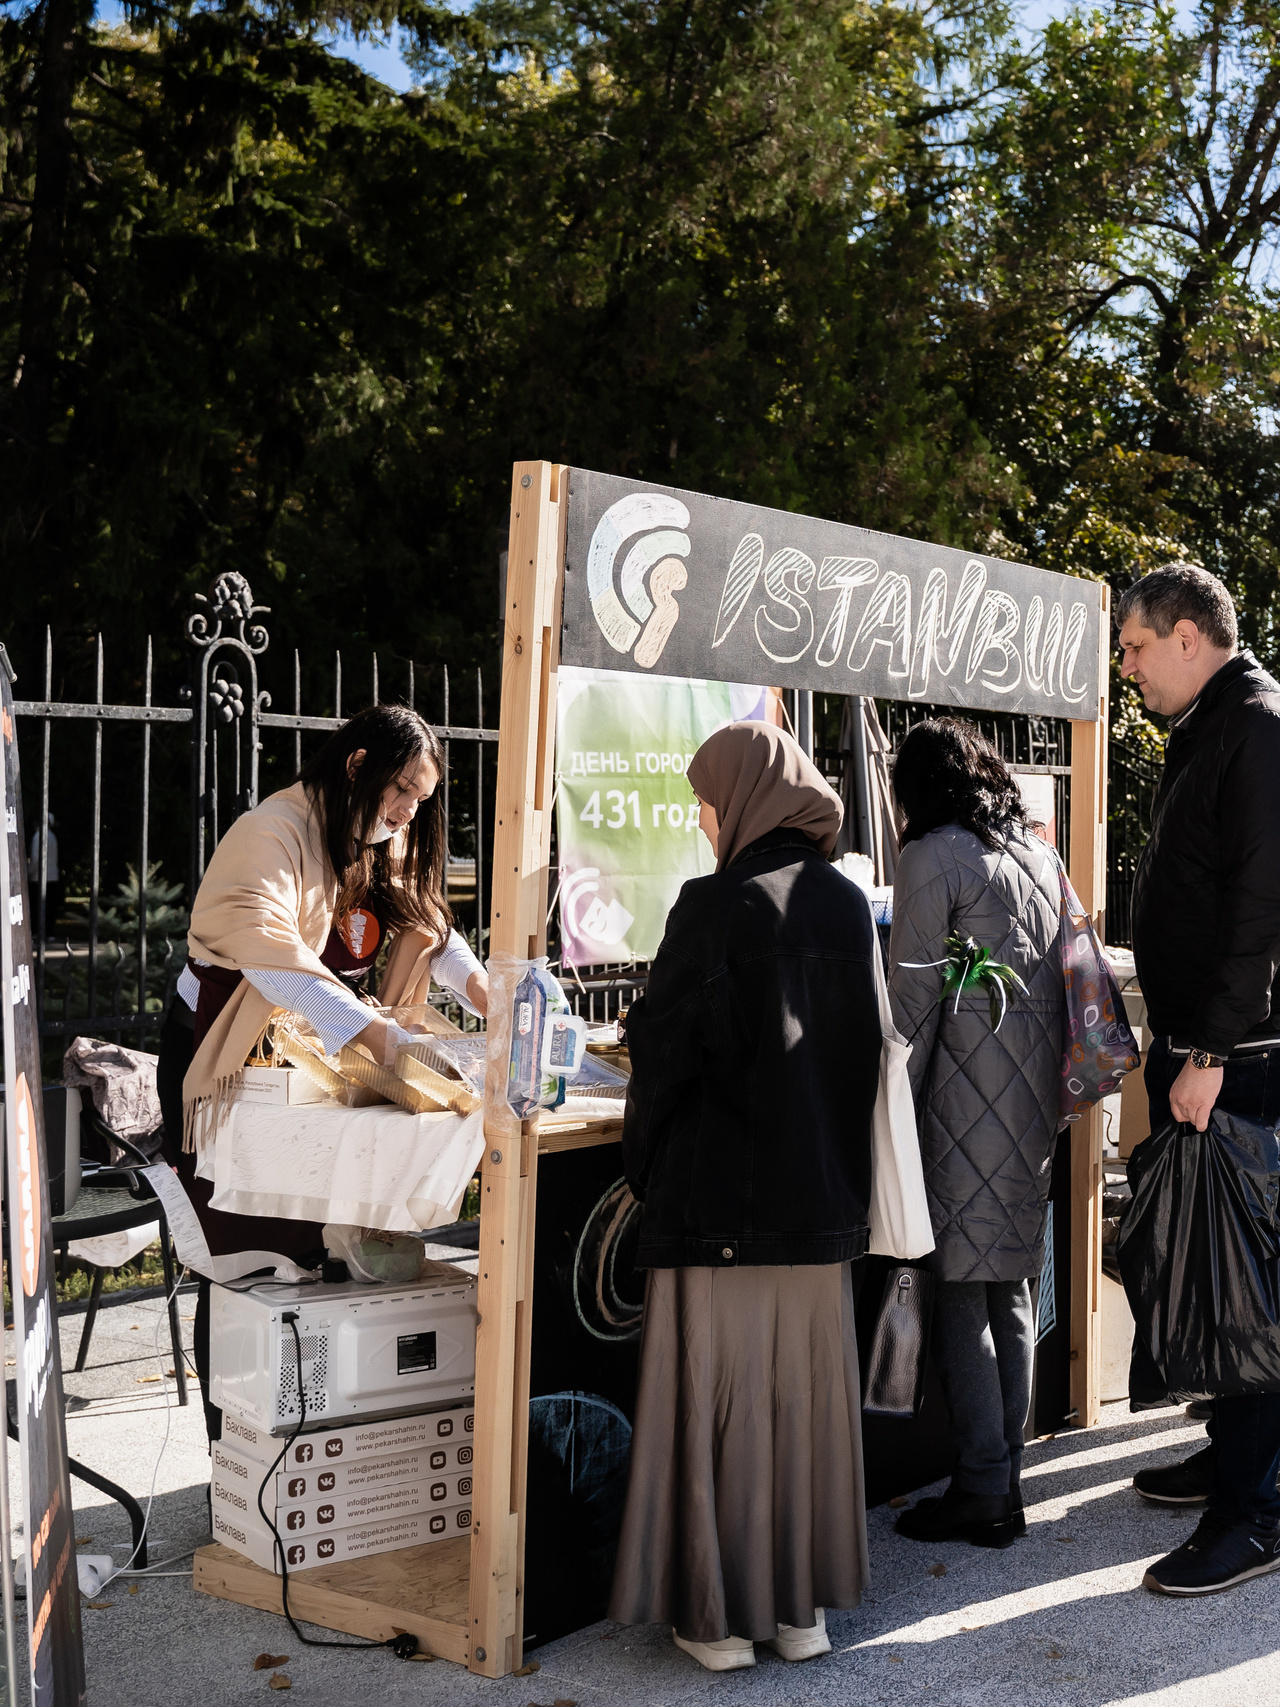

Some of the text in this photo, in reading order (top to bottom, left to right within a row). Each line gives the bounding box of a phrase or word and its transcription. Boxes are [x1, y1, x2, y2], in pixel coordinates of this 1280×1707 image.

[711, 533, 1088, 703] ISTANBUL
[570, 751, 630, 777] ДЕНЬ
[580, 789, 641, 829] 431
[551, 1032, 562, 1061] AURA
[225, 1415, 257, 1444] Баклава
[355, 1423, 426, 1441] info@pekarshahin.ru
[356, 1434, 426, 1451] www.pekarshahin.ru
[215, 1450, 248, 1479] Баклава
[347, 1456, 418, 1475] info@pekarshahin.ru
[348, 1466, 419, 1485] www.pekarshahin.ru
[215, 1482, 247, 1511] Баклава
[346, 1488, 419, 1507] info@pekarshahin.ru
[347, 1498, 419, 1517] www.pekarshahin.ru
[214, 1514, 246, 1544] Баклава
[346, 1521, 418, 1541] info@pekarshahin.ru
[348, 1531, 418, 1551] www.pekarshahin.ru
